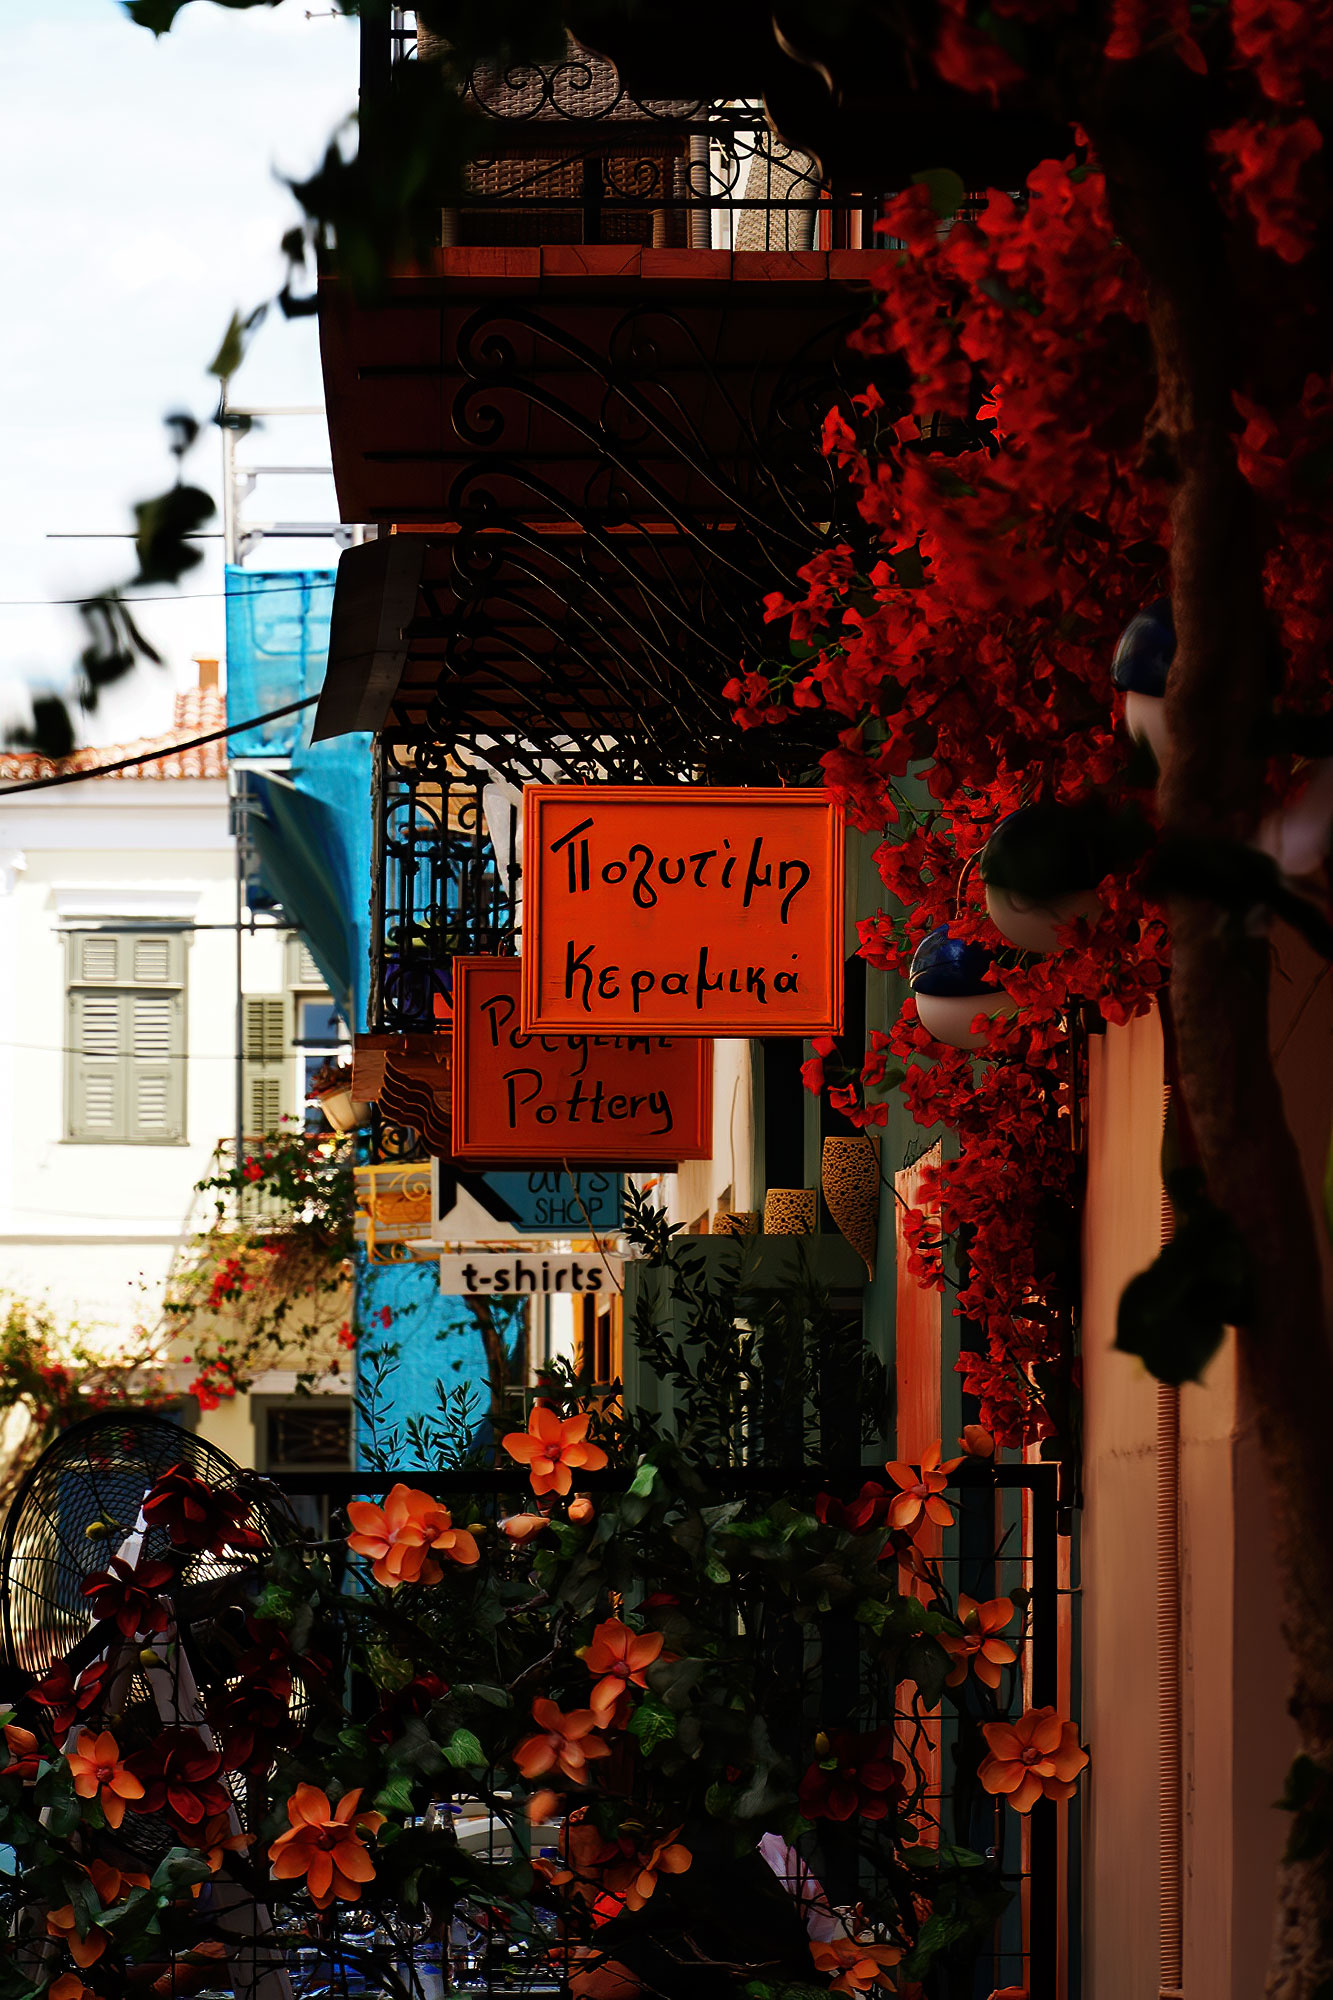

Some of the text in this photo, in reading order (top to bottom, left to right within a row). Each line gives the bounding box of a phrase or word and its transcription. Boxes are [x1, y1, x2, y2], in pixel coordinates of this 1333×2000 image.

[565, 940, 799, 1013] Κεραμικά
[503, 1068, 674, 1135] Pottery
[535, 1197, 603, 1224] SHOP
[461, 1260, 603, 1292] t-shirts
